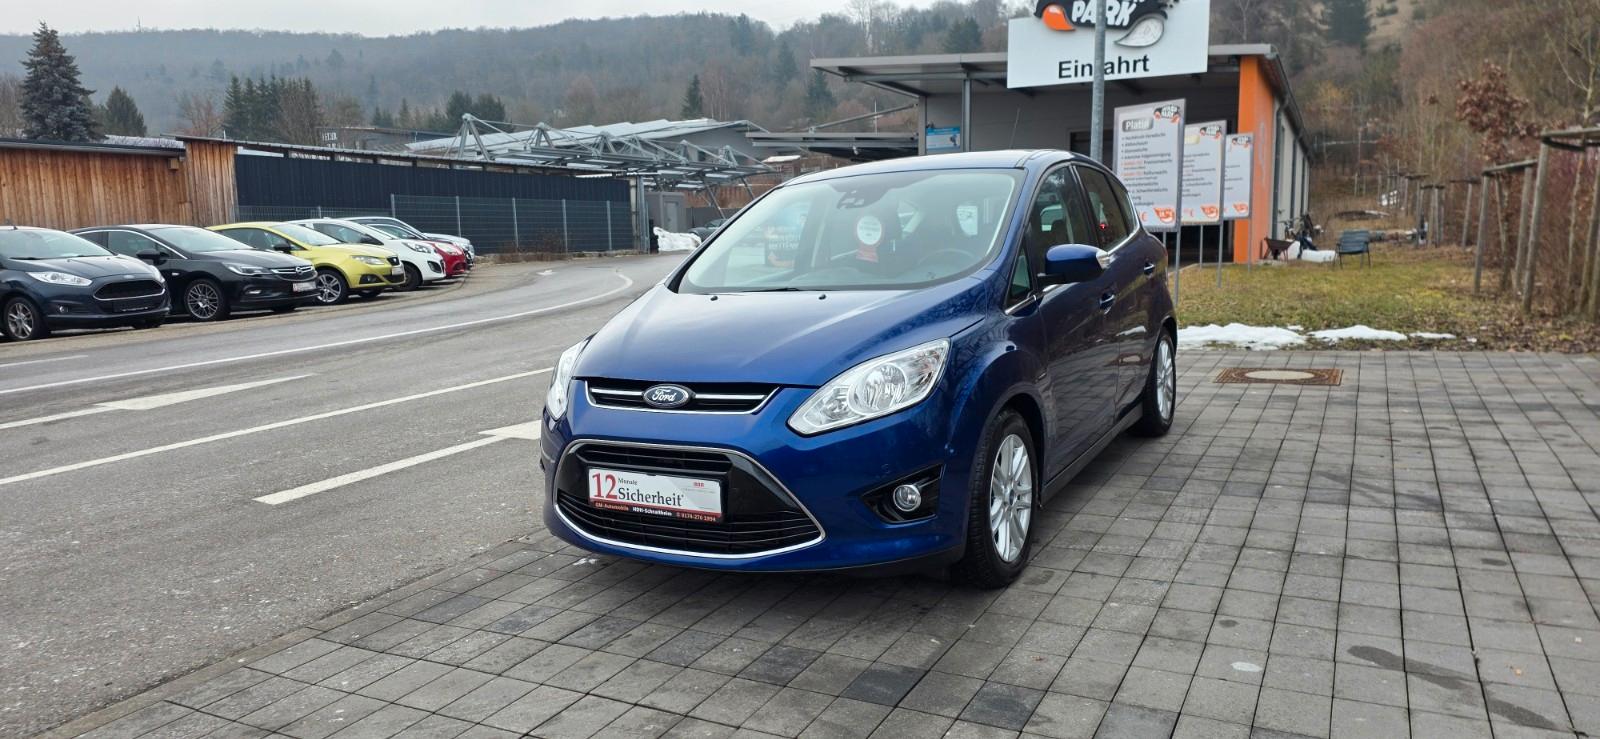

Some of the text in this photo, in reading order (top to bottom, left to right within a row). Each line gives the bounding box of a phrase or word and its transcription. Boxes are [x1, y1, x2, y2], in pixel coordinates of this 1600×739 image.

[1059, 54, 1149, 79] Einahrt
[651, 388, 677, 402] Ford
[592, 473, 617, 500] 12
